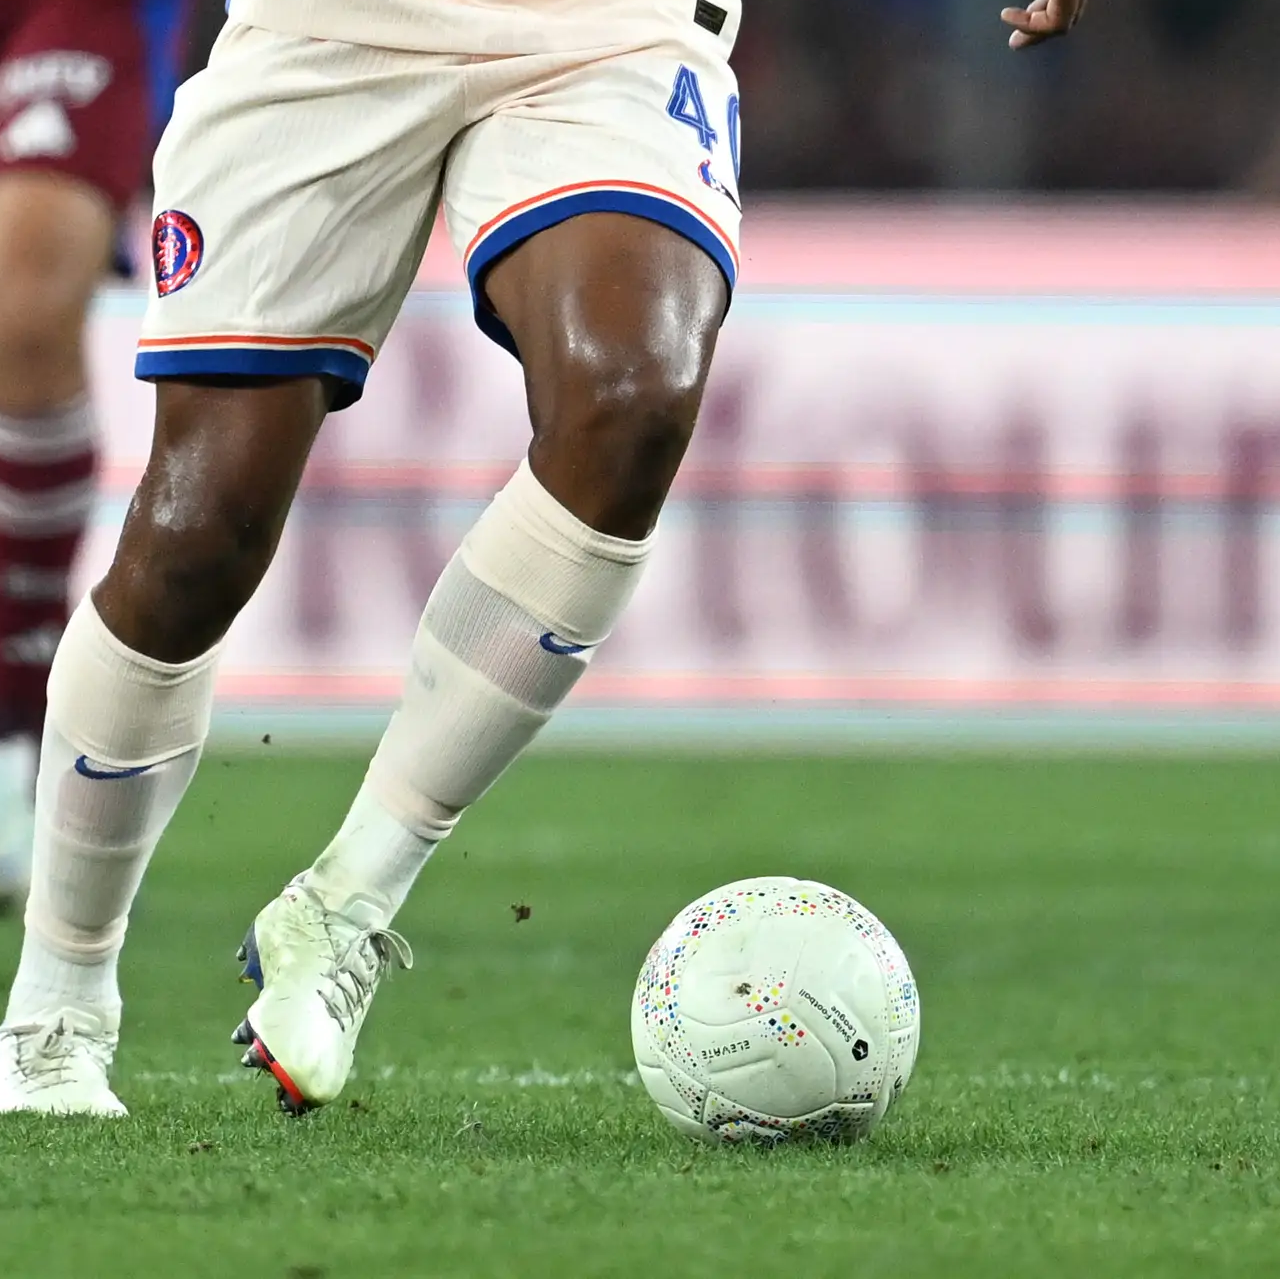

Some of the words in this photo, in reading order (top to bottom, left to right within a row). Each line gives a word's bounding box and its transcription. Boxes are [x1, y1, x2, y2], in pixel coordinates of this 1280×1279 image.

[798, 988, 832, 1021] Football
[830, 1005, 857, 1037] League
[831, 1018, 852, 1043] Swiss
[701, 1039, 751, 1060] ELEVATE
